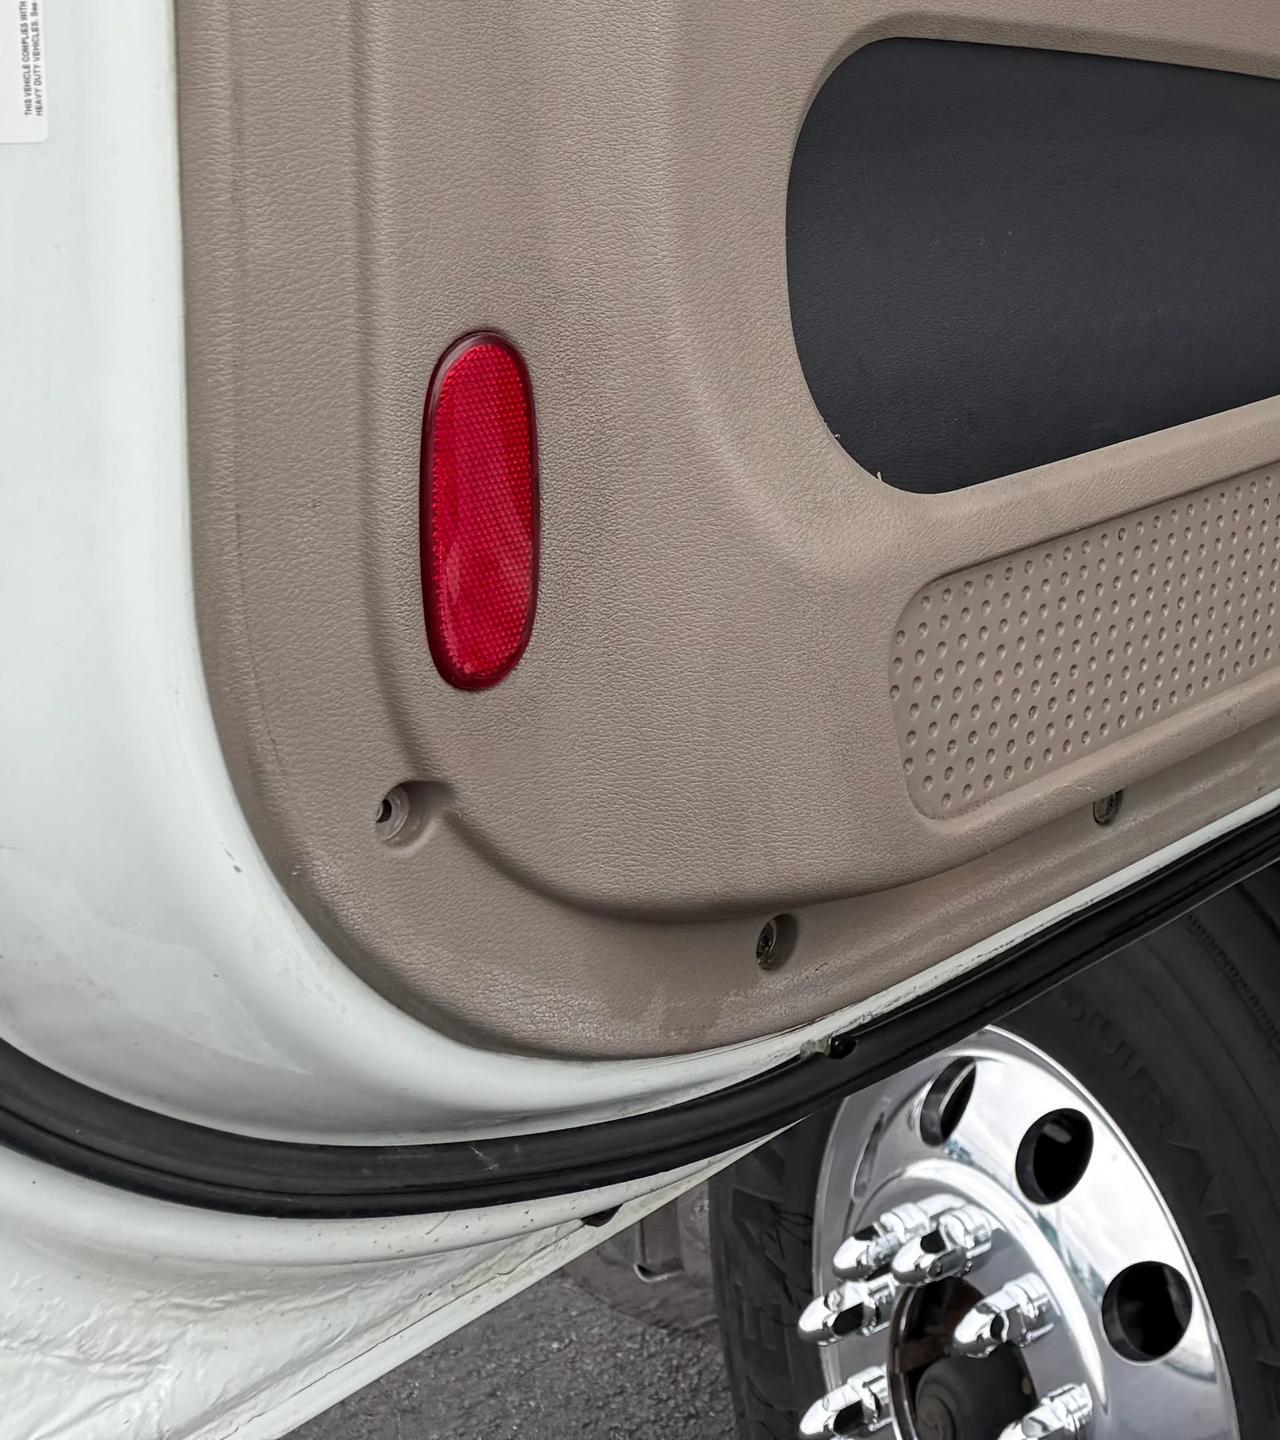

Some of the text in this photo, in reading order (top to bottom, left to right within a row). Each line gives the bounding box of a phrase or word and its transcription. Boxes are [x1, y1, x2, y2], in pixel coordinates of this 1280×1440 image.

[18, 0, 28, 21] WITH
[19, 22, 31, 63] COMPLIES
[21, 64, 32, 98] VEHICLE
[33, 64, 42, 87] DUTY
[23, 98, 33, 116] THIS
[34, 87, 43, 117] HEAVY
